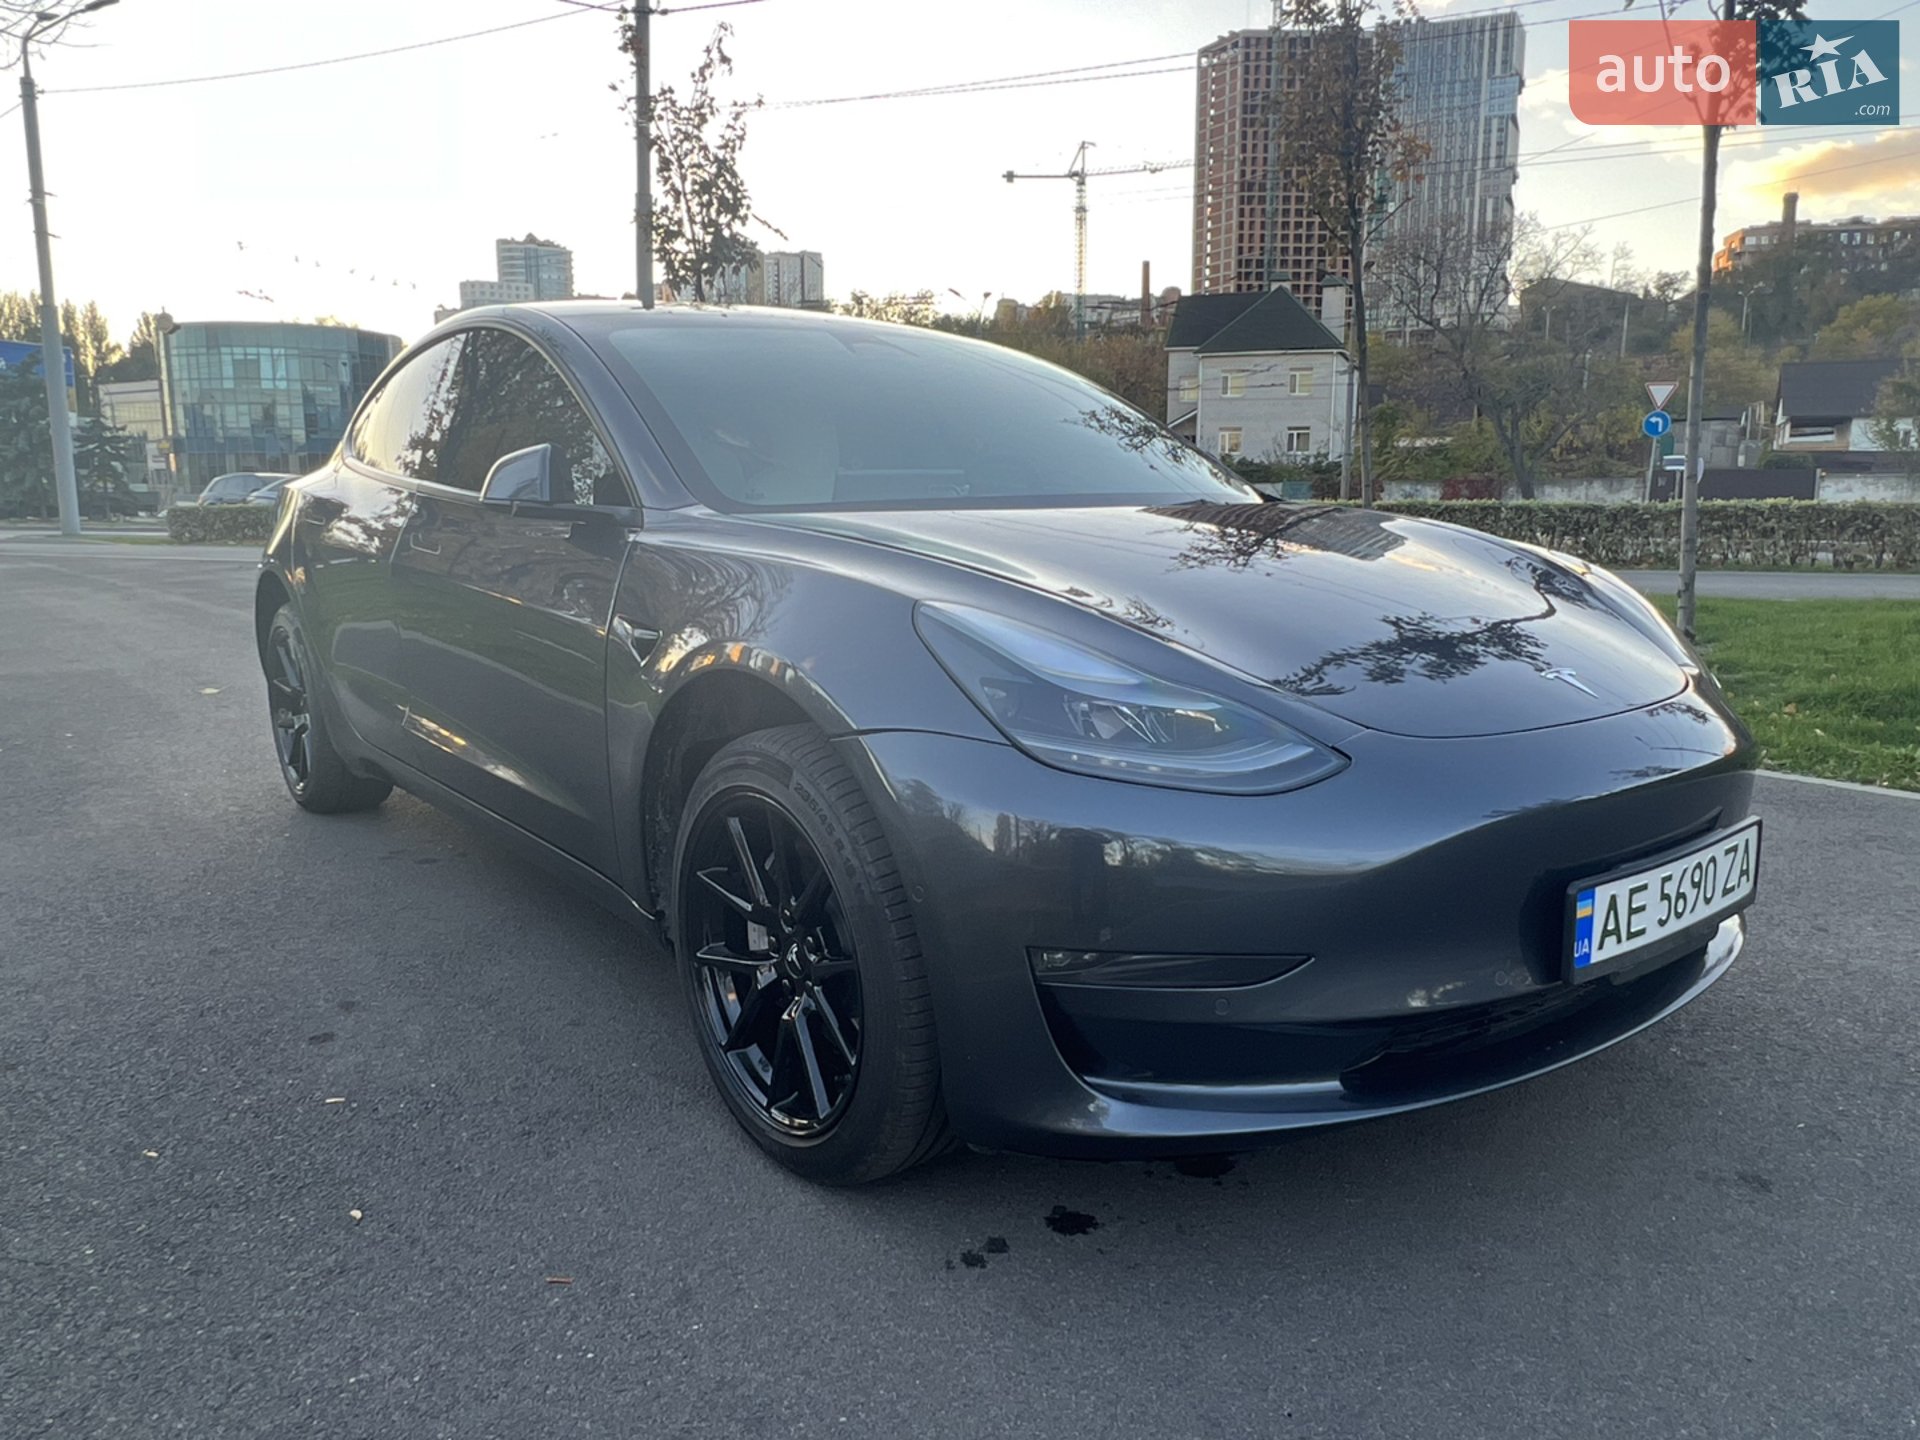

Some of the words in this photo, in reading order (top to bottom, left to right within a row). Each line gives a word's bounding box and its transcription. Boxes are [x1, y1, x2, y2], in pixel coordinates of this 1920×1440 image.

[1597, 882, 1648, 951] AE
[1657, 853, 1717, 928] 5690
[1721, 838, 1750, 899] ZA
[1574, 938, 1590, 957] UA
